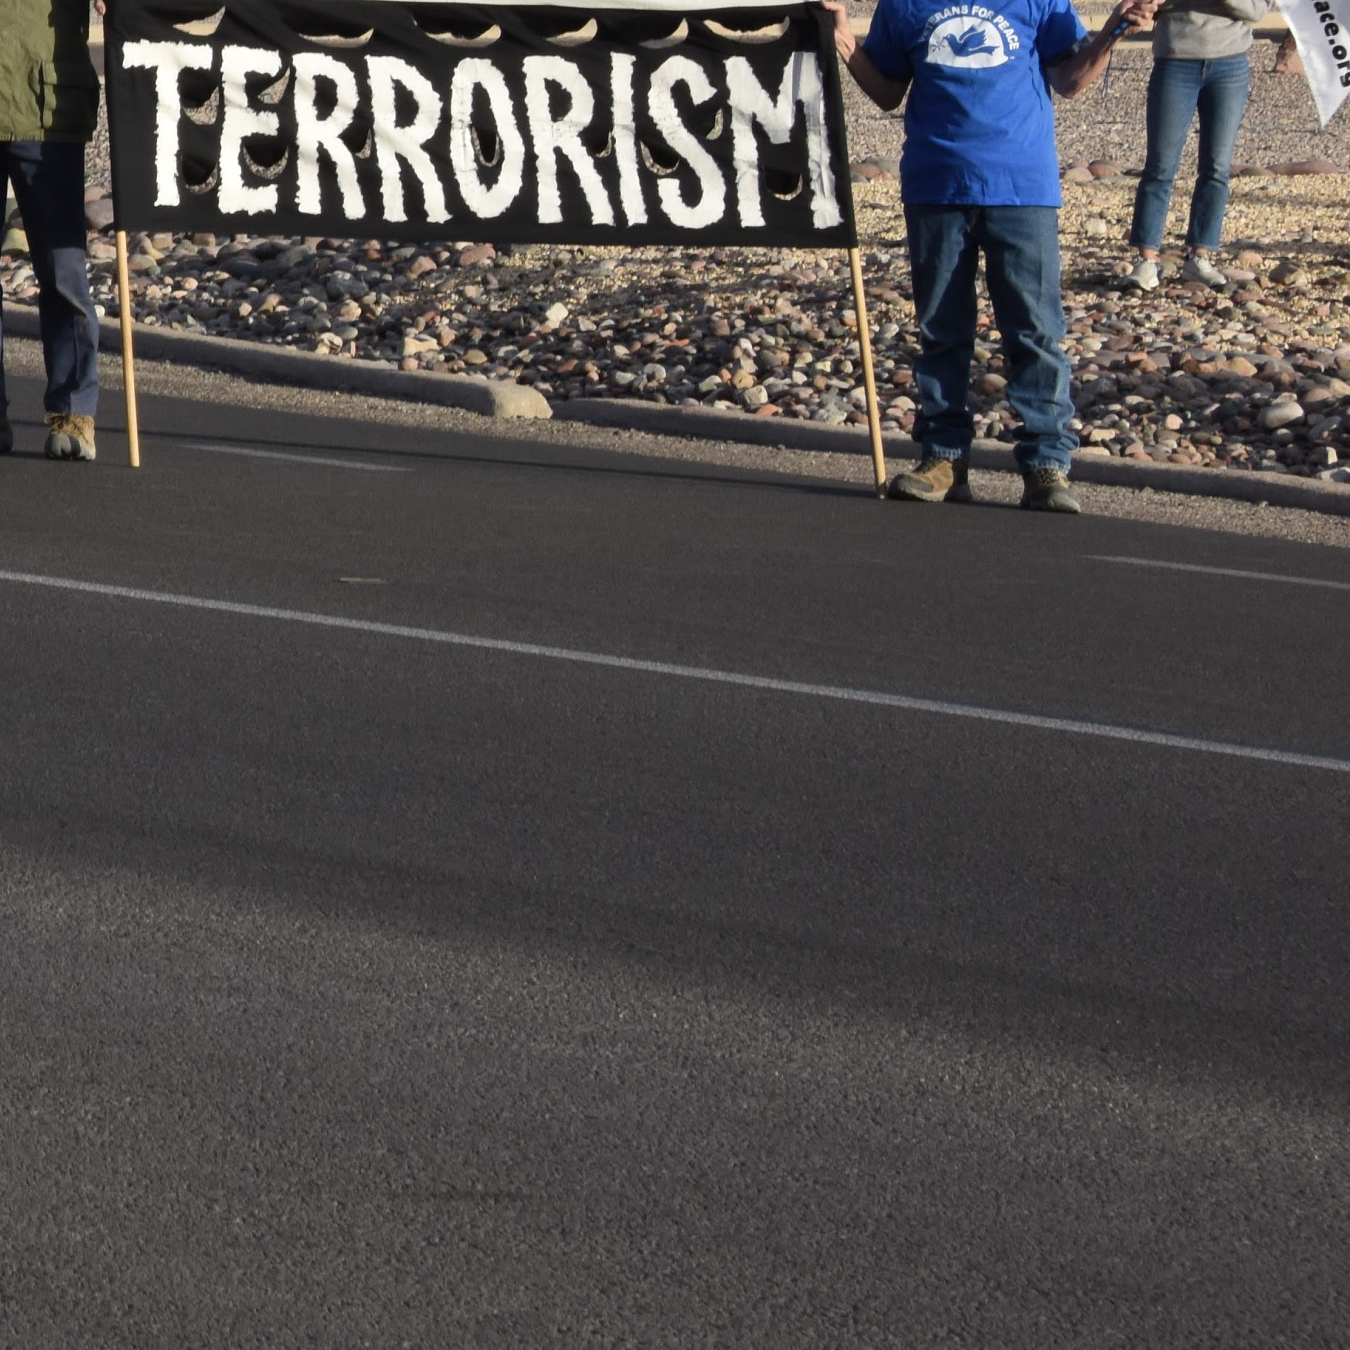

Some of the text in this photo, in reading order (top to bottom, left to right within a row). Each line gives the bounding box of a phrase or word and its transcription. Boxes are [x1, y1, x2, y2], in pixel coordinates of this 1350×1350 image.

[971, 5, 995, 19] FOR
[993, 14, 1020, 51] PEACE
[123, 39, 842, 229] TERRORISM
